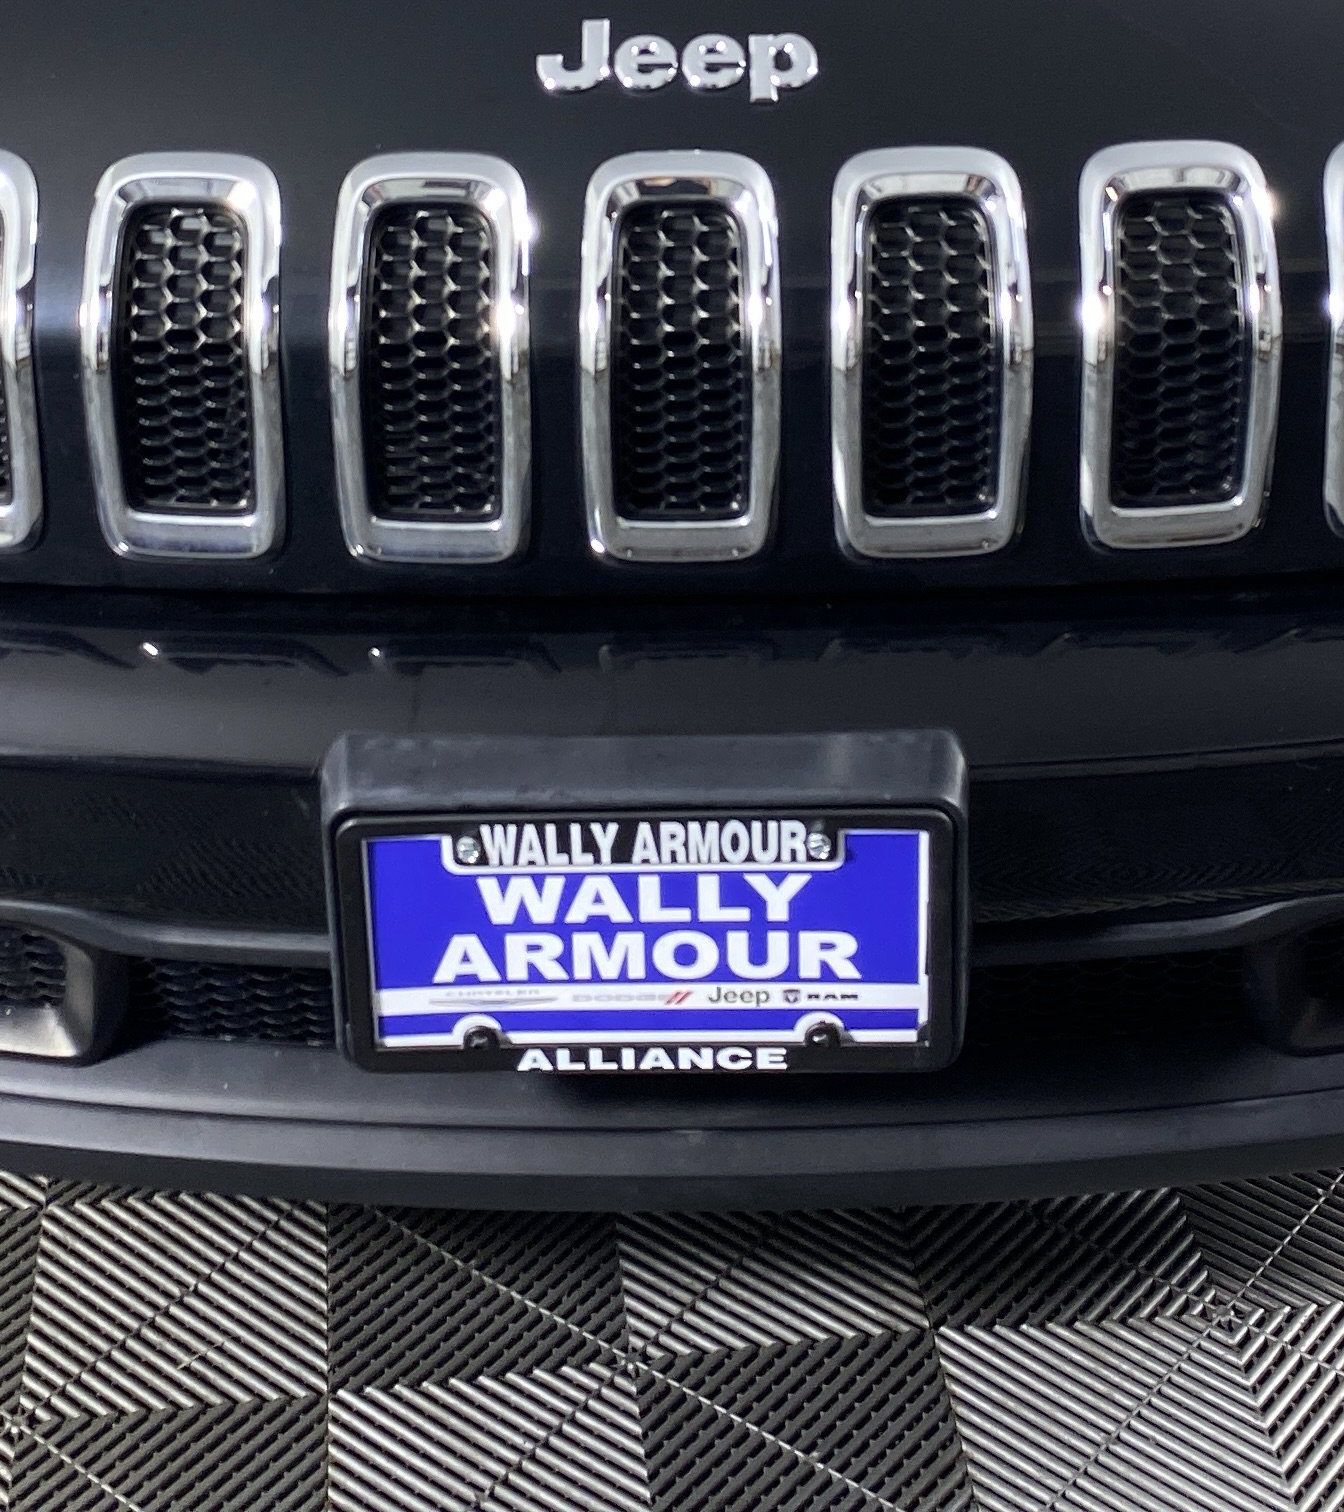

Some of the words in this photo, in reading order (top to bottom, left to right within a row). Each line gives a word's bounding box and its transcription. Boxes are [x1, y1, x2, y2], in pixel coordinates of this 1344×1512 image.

[536, 18, 819, 102] Jeep
[479, 822, 619, 866] WALLY
[632, 820, 806, 864] ARMOUR
[477, 874, 813, 925] WALLY
[432, 930, 862, 982] ARMOUR
[708, 987, 770, 1006] Jeep
[807, 993, 858, 1001] RAM
[516, 1046, 788, 1072] ALLIANCE
